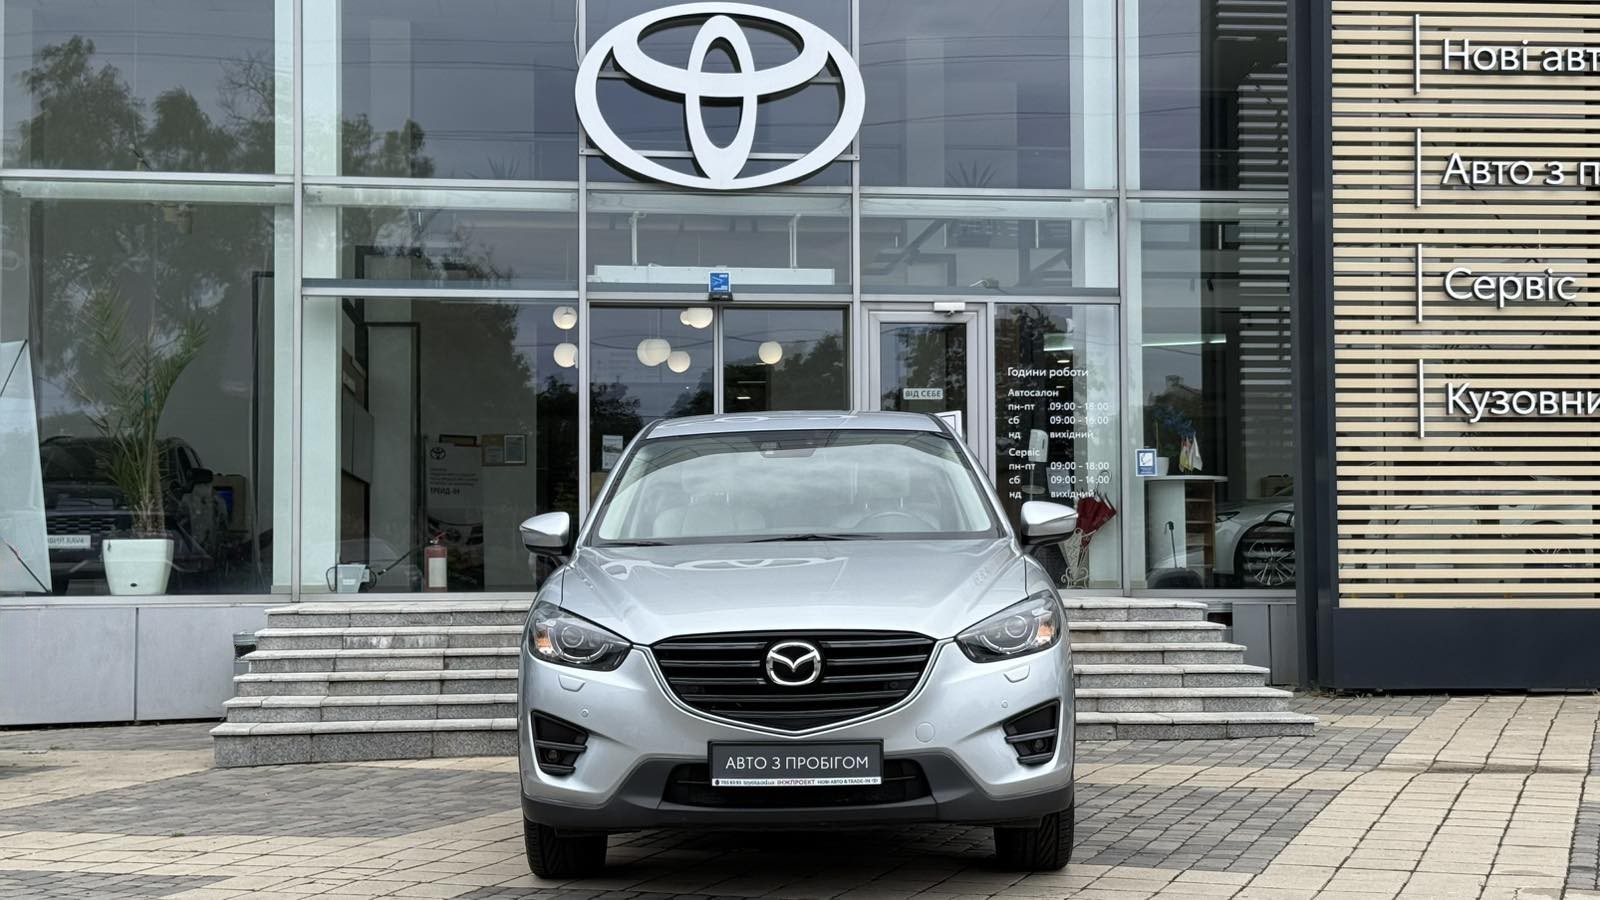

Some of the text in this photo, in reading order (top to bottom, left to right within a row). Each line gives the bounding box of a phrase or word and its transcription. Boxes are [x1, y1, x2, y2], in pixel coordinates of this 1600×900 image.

[1443, 38, 1529, 71] Нові
[1442, 152, 1533, 185] Авто
[1544, 161, 1565, 185] з
[1444, 267, 1577, 309] Сервіс
[1007, 366, 1089, 379] Години роботи
[905, 390, 919, 398] ВІД
[1007, 388, 1059, 397] Автосалон
[1007, 403, 1035, 411] пн-пт
[1049, 402, 1076, 411] 09:00
[1085, 402, 1110, 411] 18:00
[1447, 382, 1600, 423] Кузовни
[1007, 415, 1020, 425] сб
[1049, 416, 1076, 425] 09:00
[1008, 430, 1095, 440] нд вихідний
[1008, 448, 1041, 458] Сервіс
[1050, 461, 1077, 470] 09:00
[1085, 461, 1110, 470] 18:00
[1008, 475, 1021, 485] сб
[1050, 475, 1077, 484] 09:00
[1085, 475, 1110, 484] 14:00
[1009, 489, 1095, 499] нд вихідний
[725, 755, 869, 770] АВТО З ПРОБІГОМ
